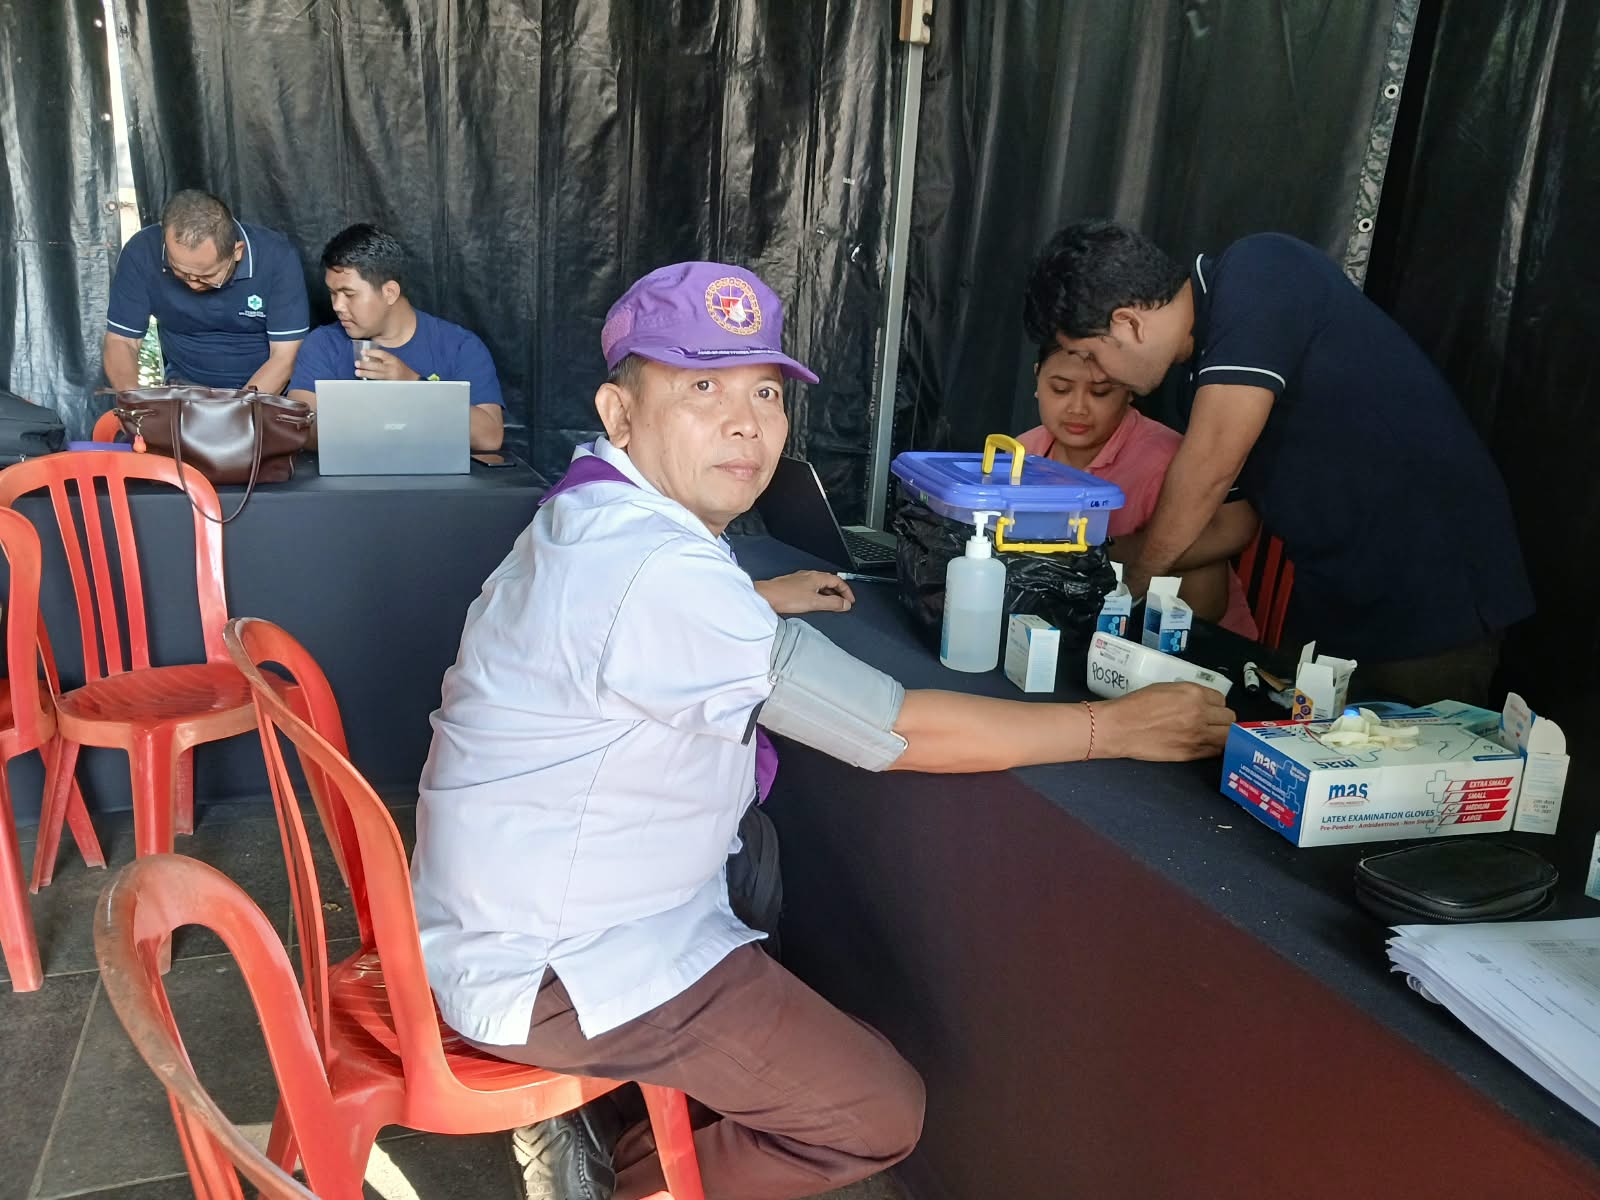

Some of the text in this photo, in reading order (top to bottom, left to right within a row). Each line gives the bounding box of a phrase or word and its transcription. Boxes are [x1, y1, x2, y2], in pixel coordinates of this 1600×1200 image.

[1328, 783, 1368, 800] mas
[1321, 809, 1436, 823] LATEX EXAMINATION GLOVES
